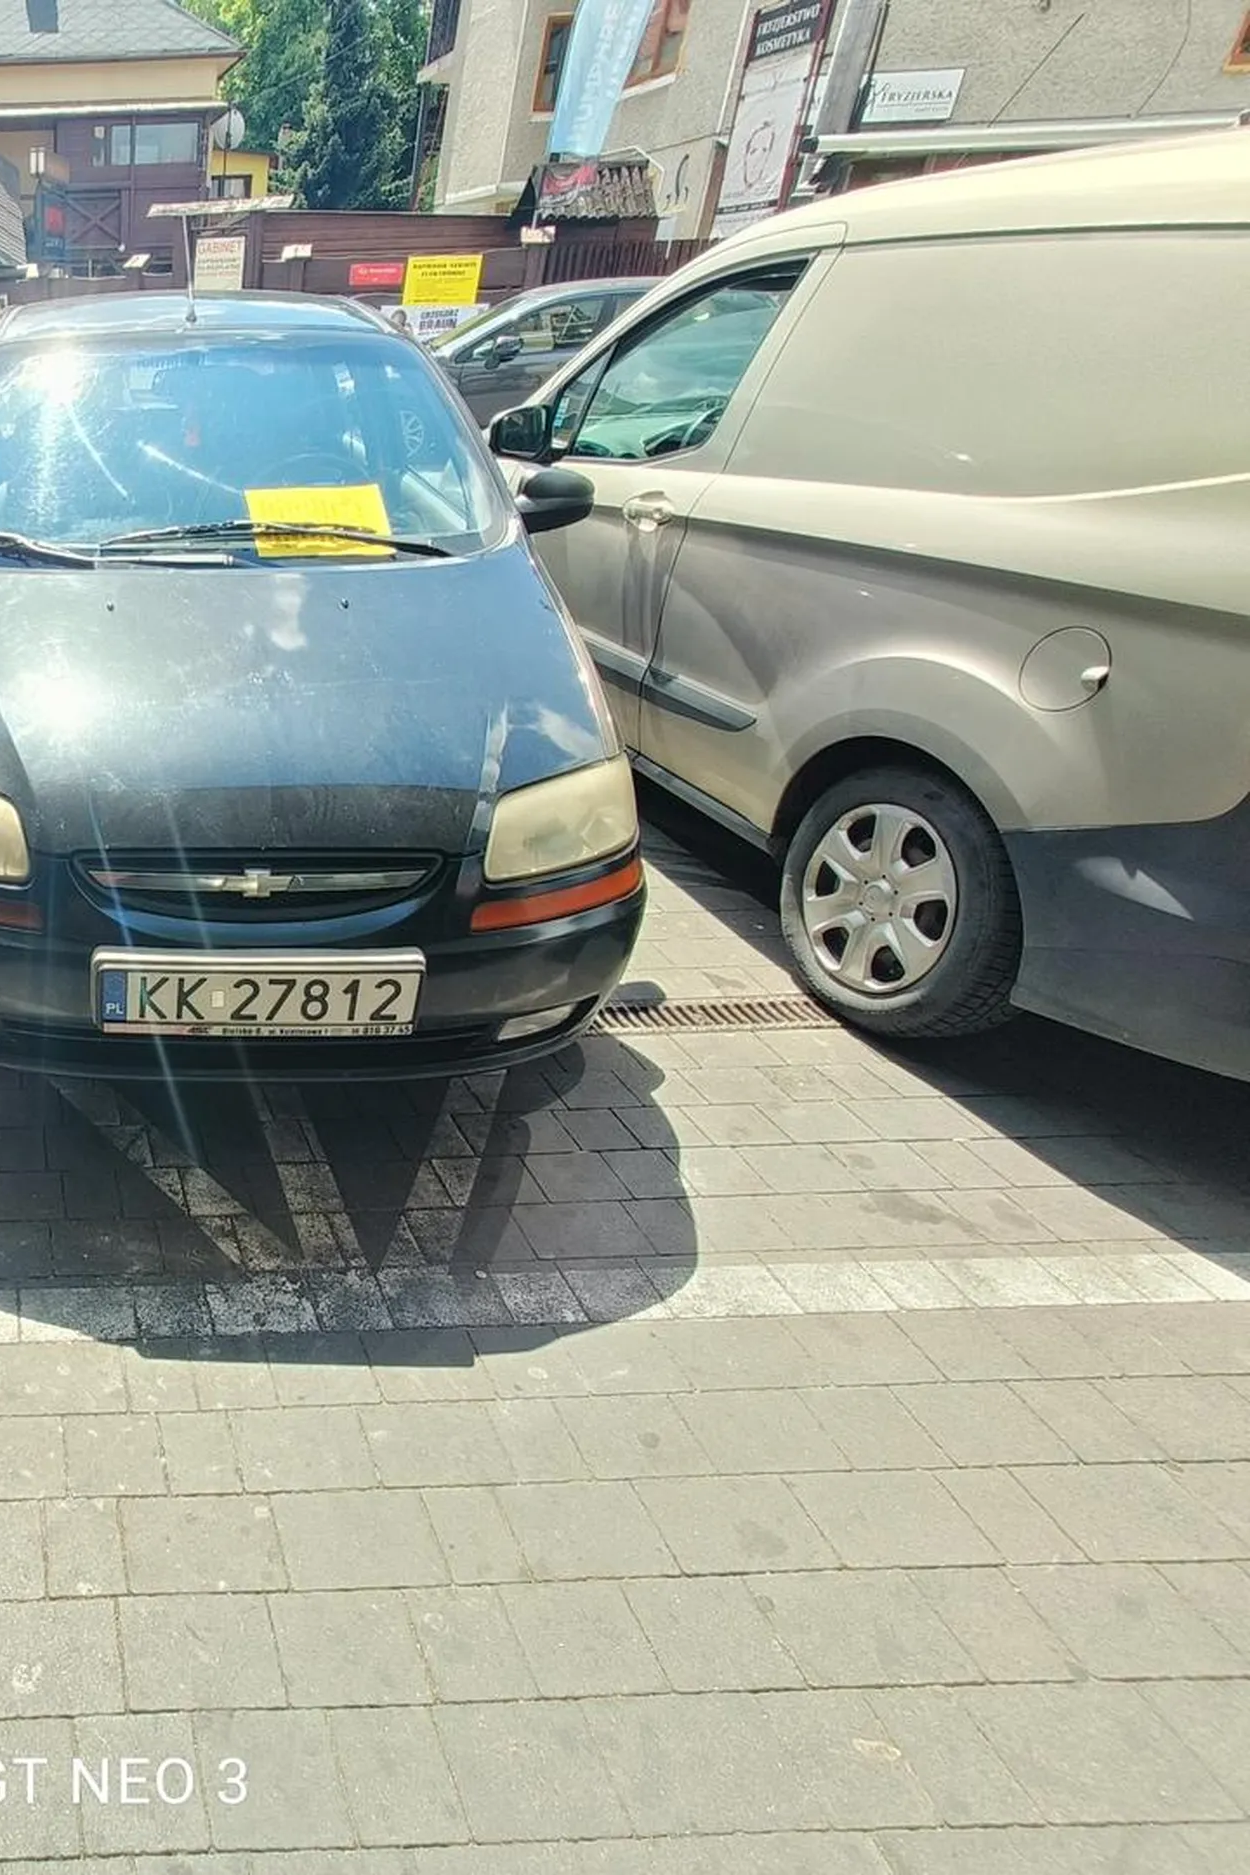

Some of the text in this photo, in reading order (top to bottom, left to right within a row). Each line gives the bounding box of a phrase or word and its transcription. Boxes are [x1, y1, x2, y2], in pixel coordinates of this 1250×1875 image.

[755, 28, 810, 57] KOSMETYKA
[421, 309, 459, 320] GRZEGORZ
[419, 318, 458, 331] BRAUN
[139, 976, 402, 1021] KK 27812
[106, 1002, 124, 1015] PL
